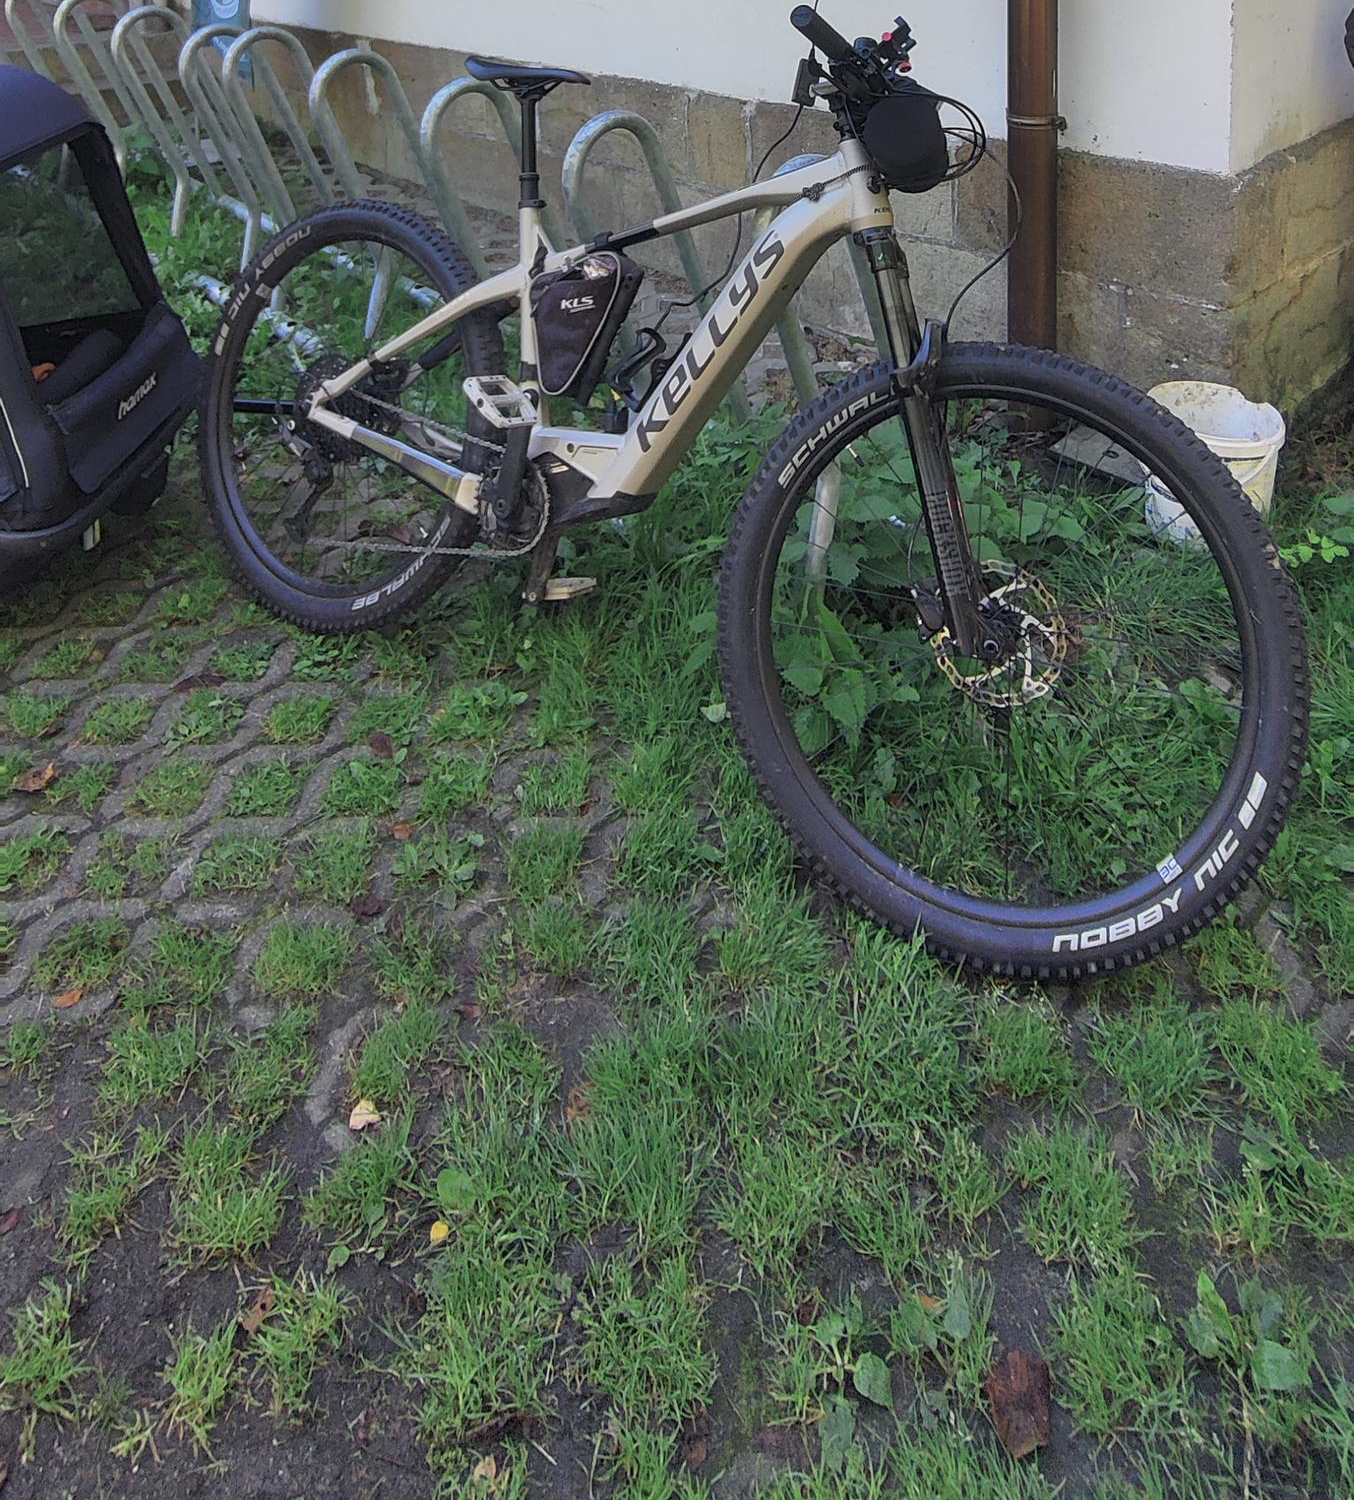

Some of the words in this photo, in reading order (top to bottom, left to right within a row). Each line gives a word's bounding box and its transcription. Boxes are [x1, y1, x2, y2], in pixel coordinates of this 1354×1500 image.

[560, 295, 594, 310] KLS
[117, 371, 158, 421] hamax
[777, 382, 896, 489] SCHWAL
